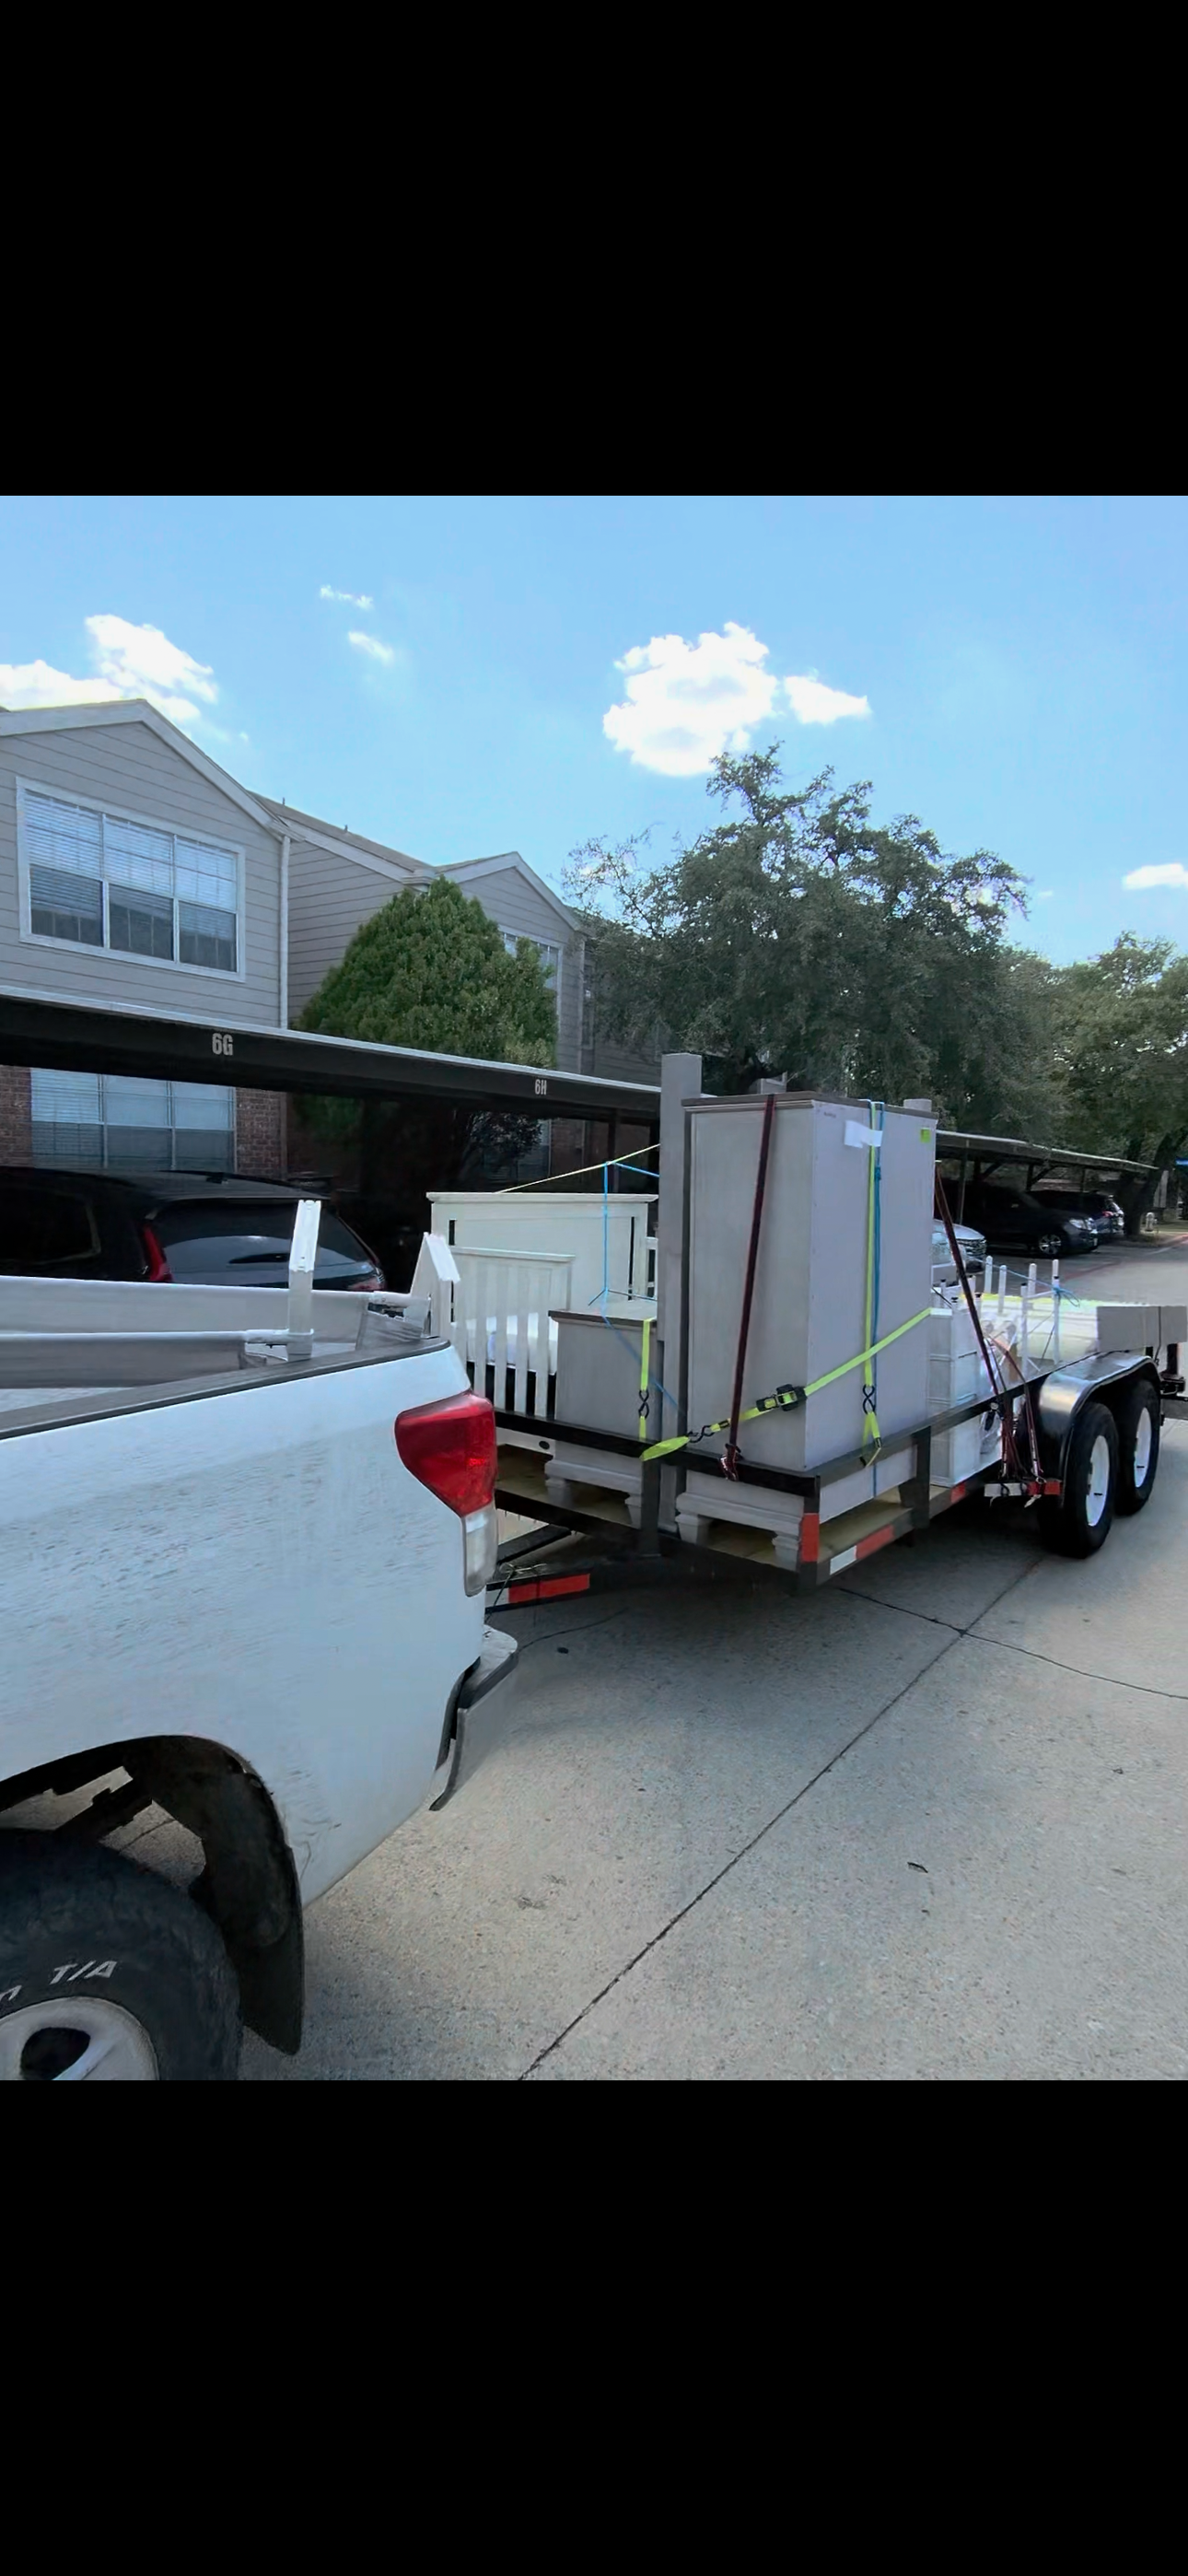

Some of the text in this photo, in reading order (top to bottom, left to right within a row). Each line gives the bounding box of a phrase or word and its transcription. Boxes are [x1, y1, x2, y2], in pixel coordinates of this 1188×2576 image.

[212, 1033, 234, 1056] 6G
[535, 1079, 547, 1095] 6H
[49, 1960, 118, 1985] T/A
